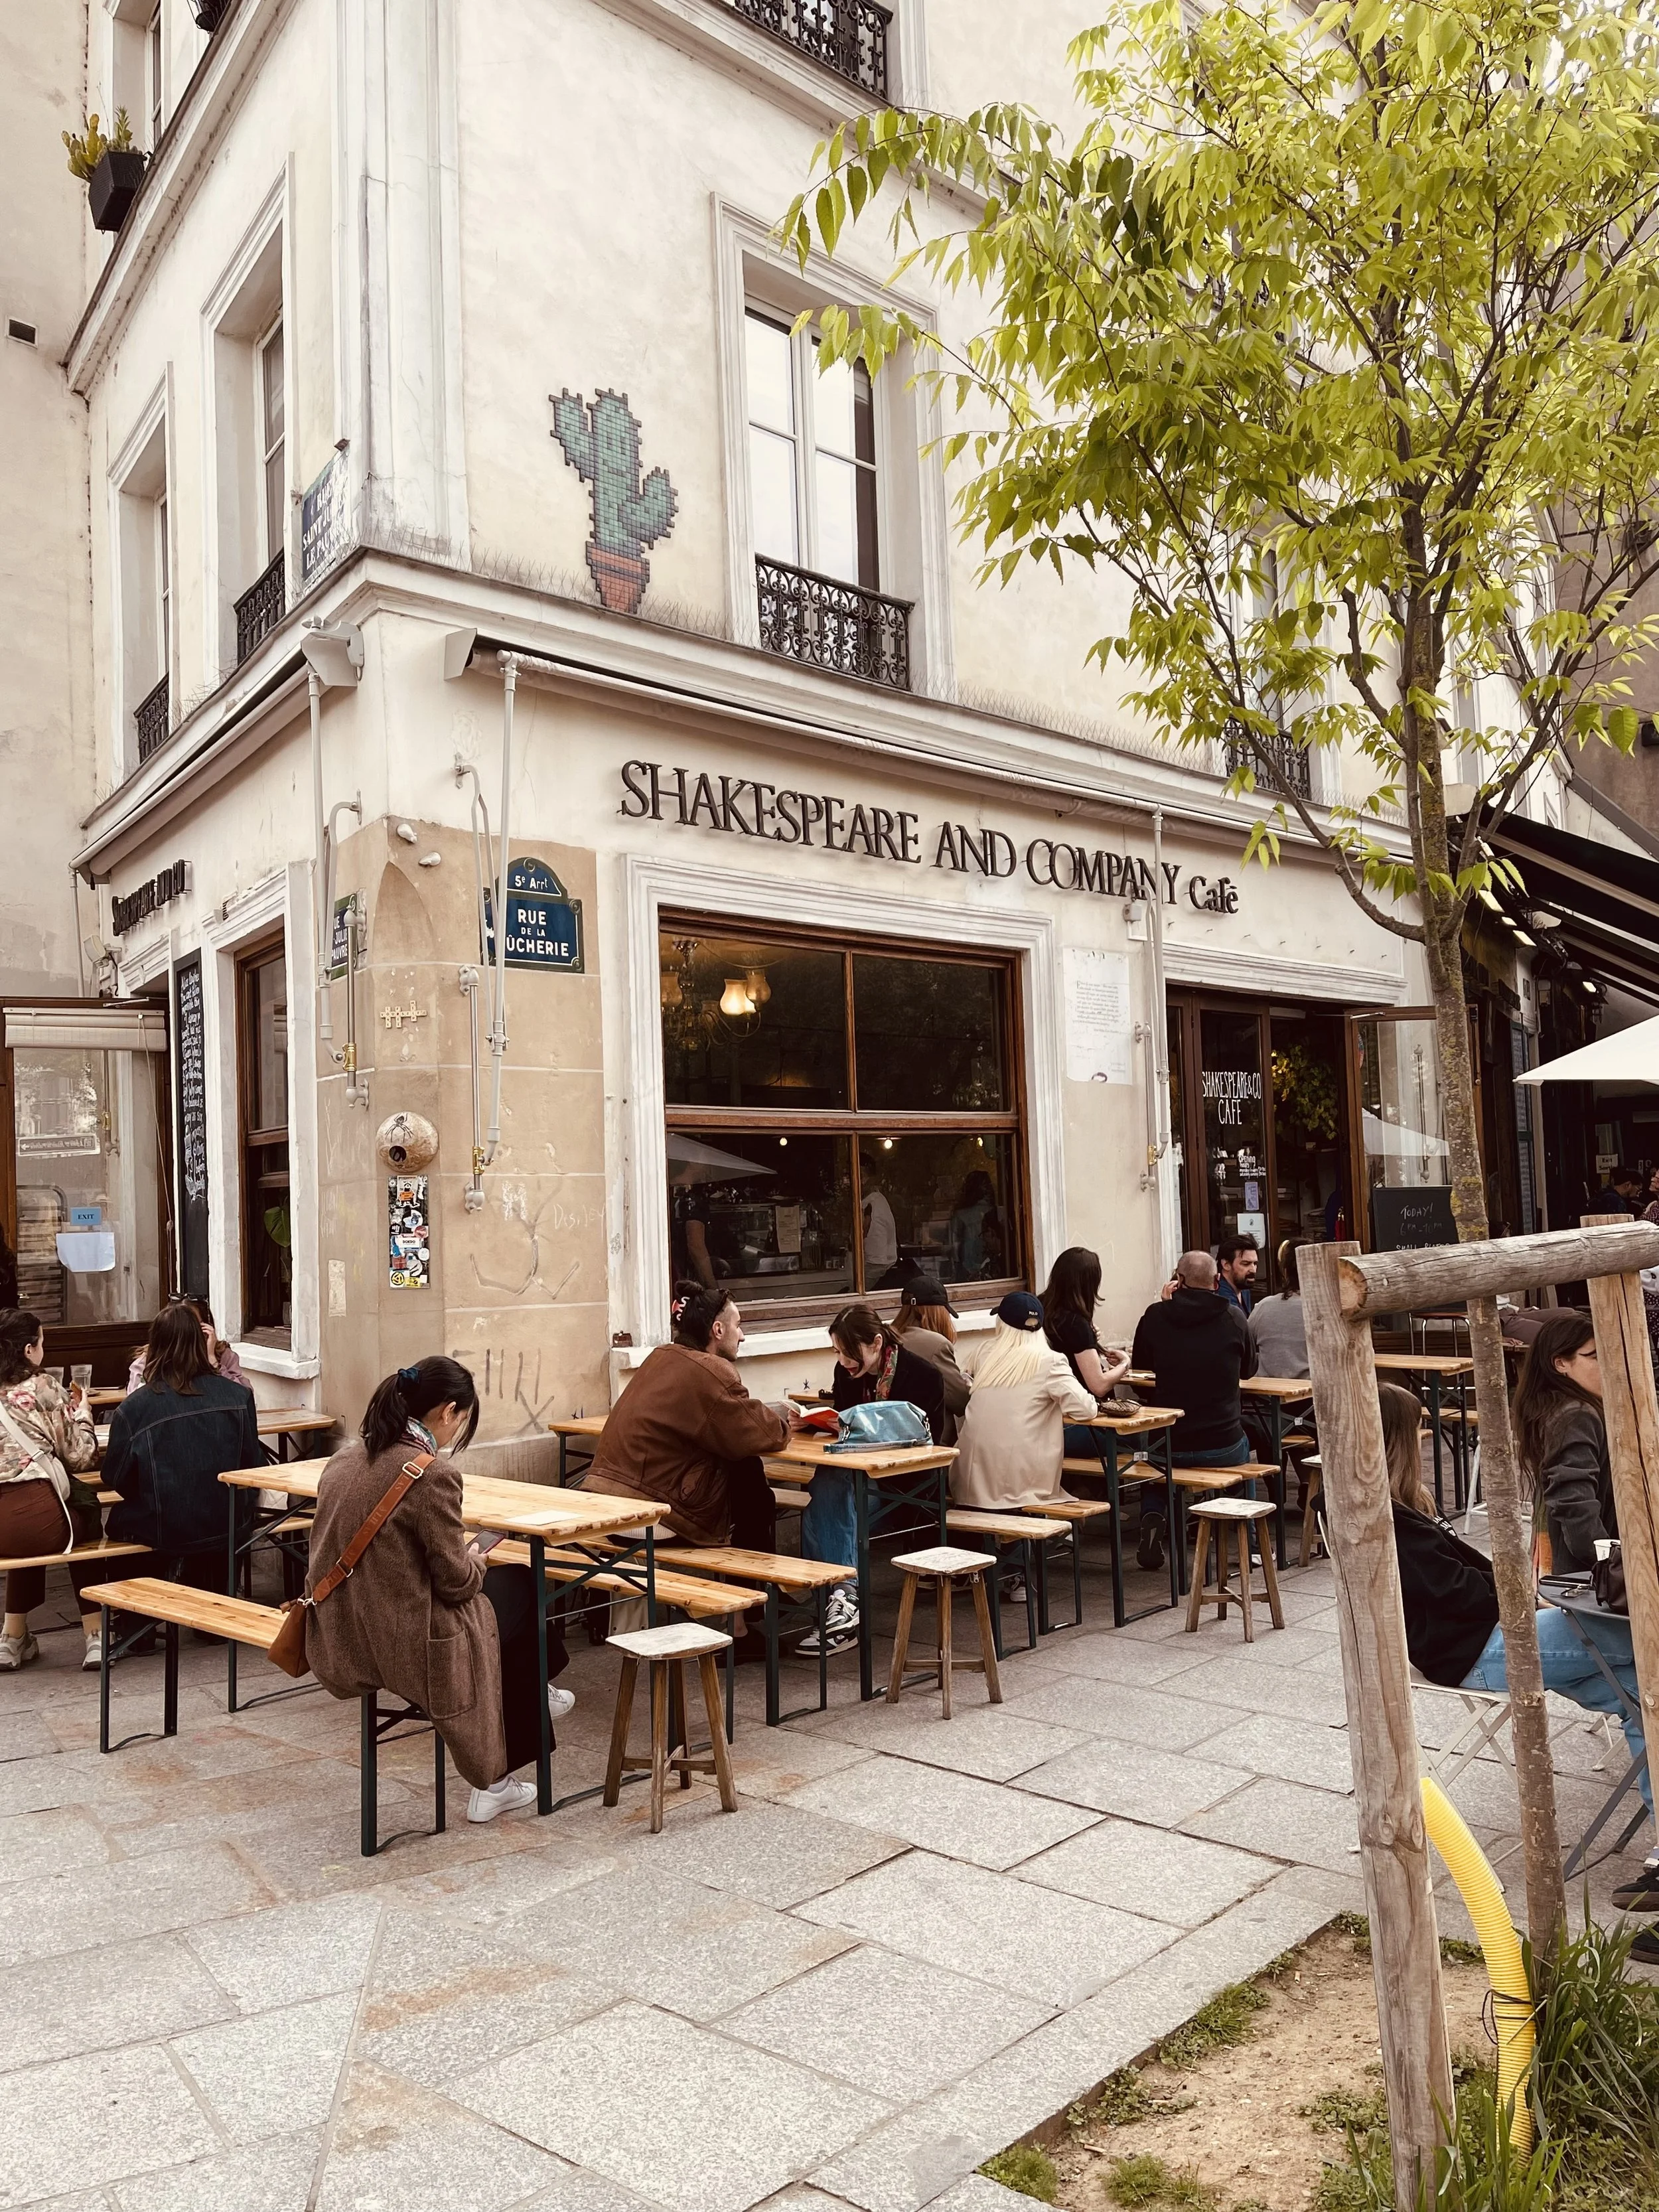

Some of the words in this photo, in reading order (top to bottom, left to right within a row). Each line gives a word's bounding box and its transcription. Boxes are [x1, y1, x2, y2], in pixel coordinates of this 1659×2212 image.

[317, 479, 332, 512] RUE
[303, 514, 323, 552] SAINT
[306, 548, 316, 570] LE
[621, 760, 922, 863] SHAKESPEARE
[930, 822, 1017, 877] AND
[1027, 838, 1182, 905] COMPANY
[1189, 875, 1239, 914] Café
[518, 909, 547, 925] RUE
[506, 934, 570, 956] ÛCHERIE
[1218, 1099, 1242, 1124] CAFE
[1400, 1202, 1433, 1220] TODAY!
